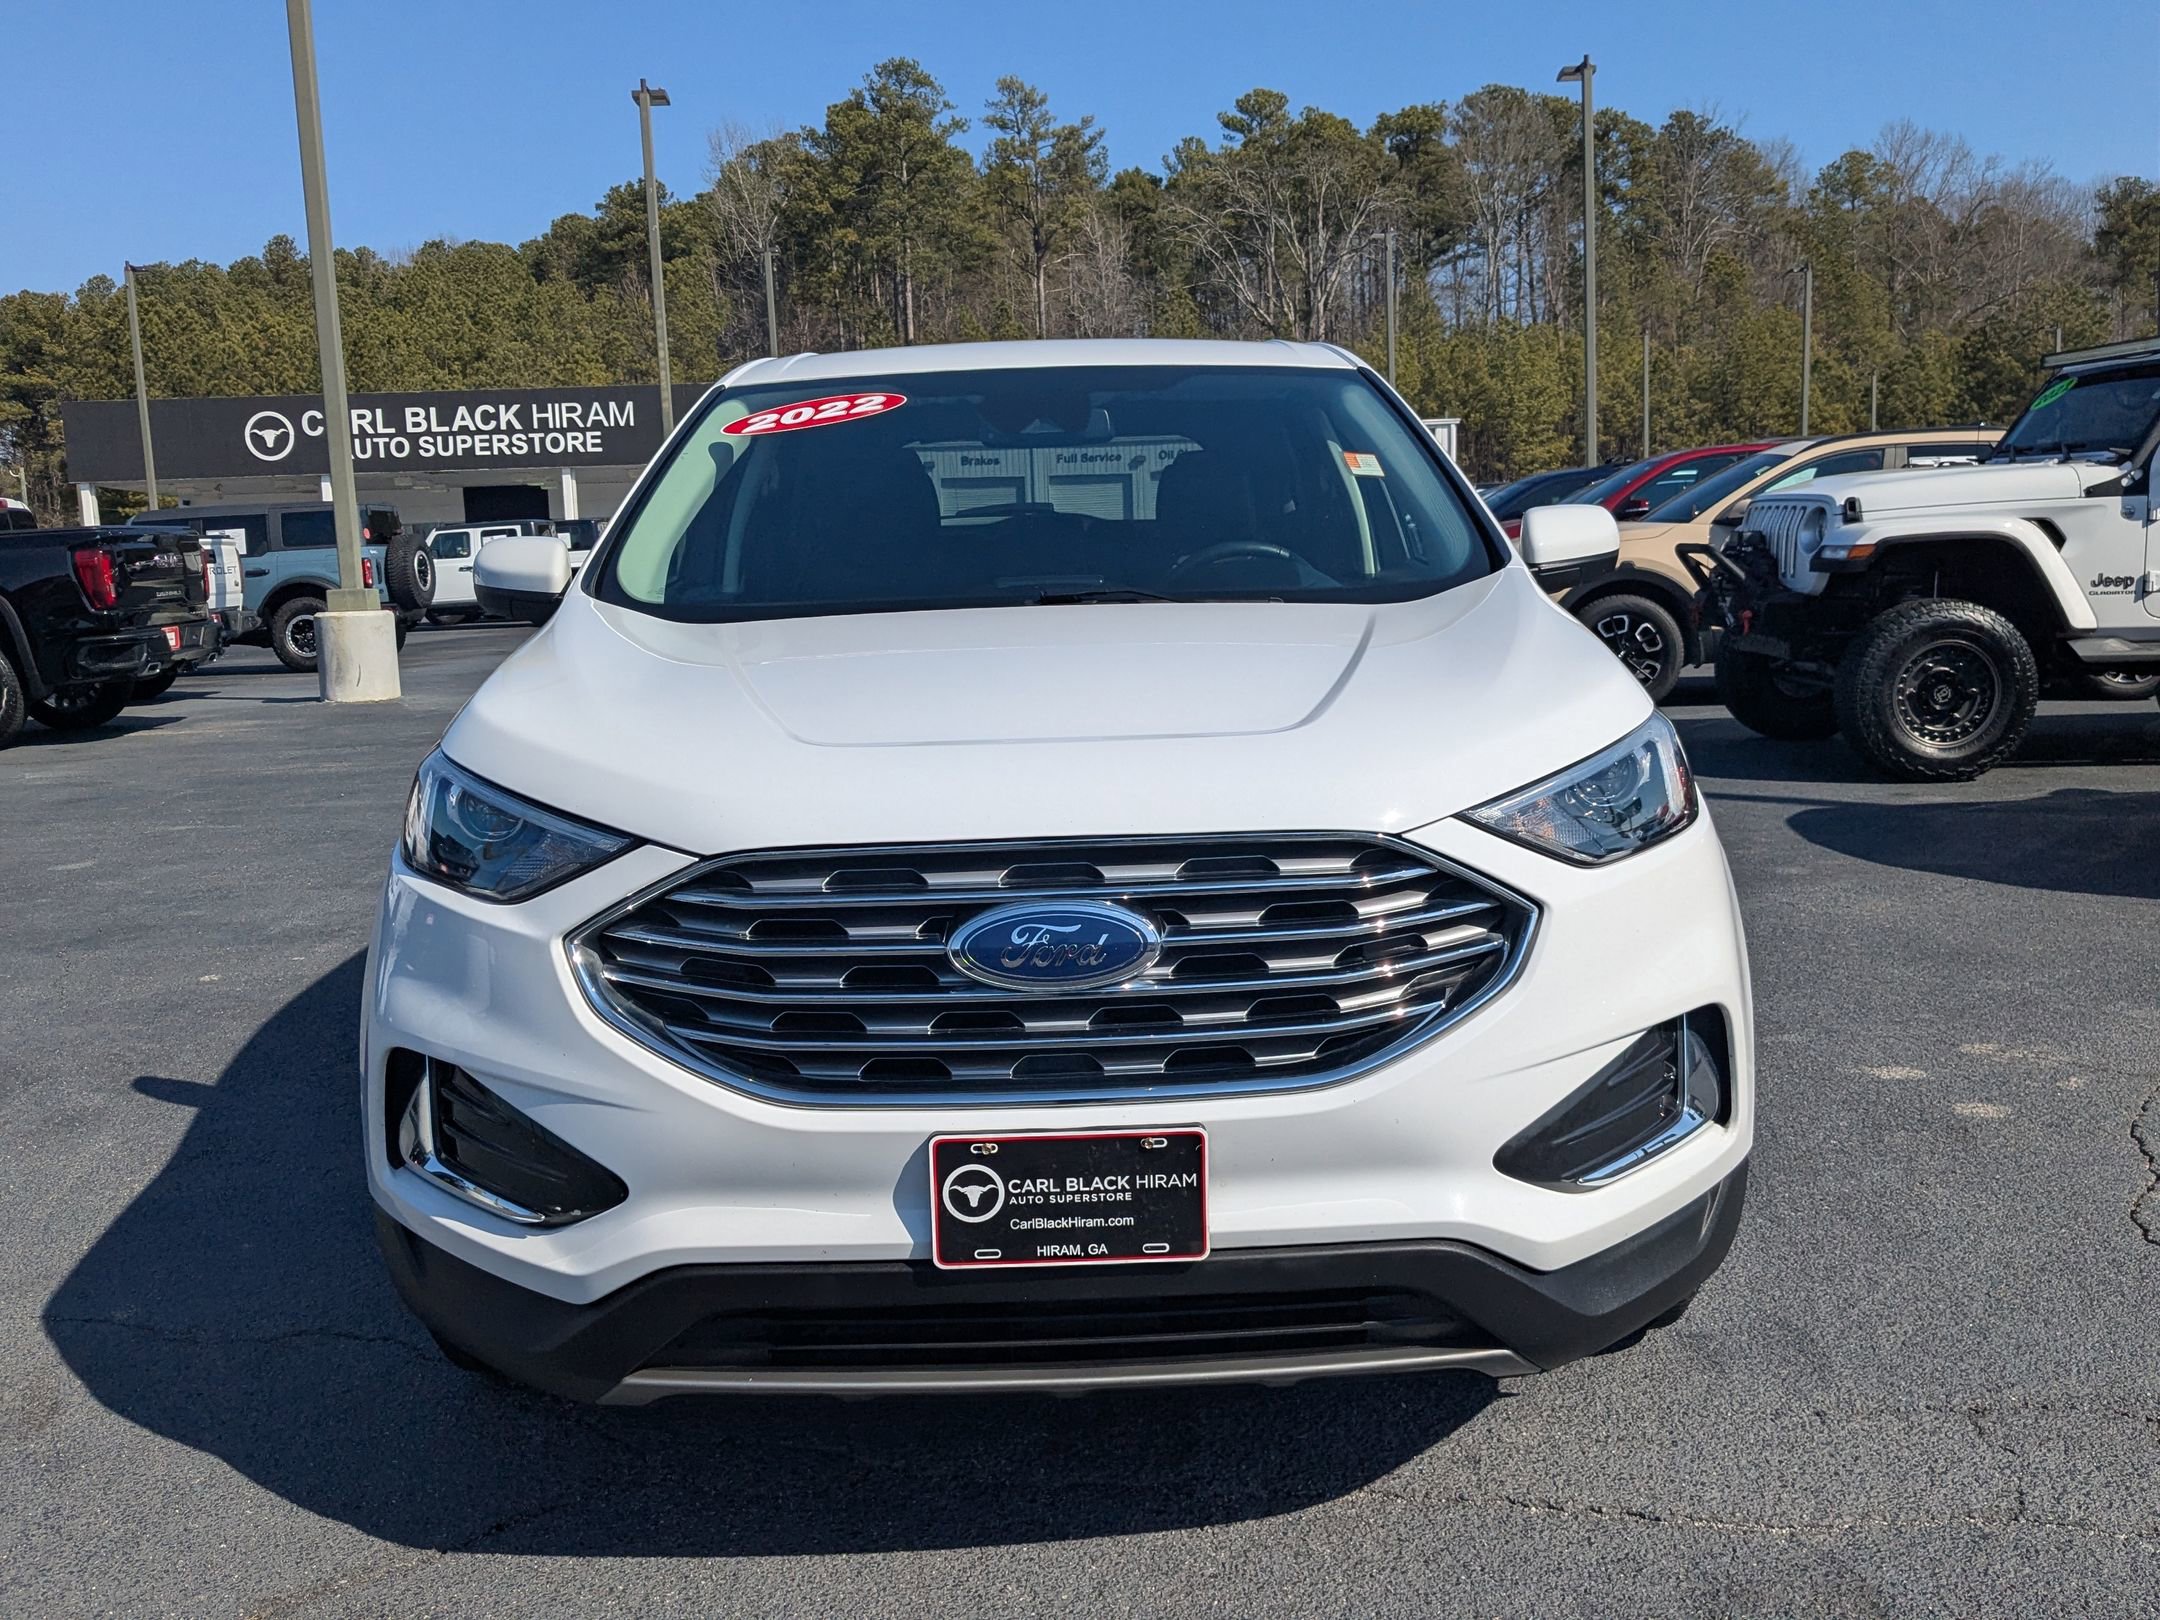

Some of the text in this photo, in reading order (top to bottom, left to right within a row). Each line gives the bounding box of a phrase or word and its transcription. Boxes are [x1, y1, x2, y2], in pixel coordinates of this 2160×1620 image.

[301, 401, 635, 437] CRL BLACK HIRAM
[741, 395, 887, 433] 2022
[351, 431, 603, 460] UTO SUPERSTORE
[960, 456, 1000, 466] Brakes
[1056, 452, 1122, 464] Full Service
[1158, 449, 1174, 460] Oil
[2090, 573, 2135, 590] Jeep
[1001, 923, 1109, 968] Ford
[1008, 1173, 1197, 1194] CARL BLACK HIRAM
[1009, 1192, 1132, 1205] AUTO SUPERSTORE
[1010, 1216, 1134, 1230] CarlBlackHiram.com
[1037, 1244, 1108, 1258] HIRAM, GA
